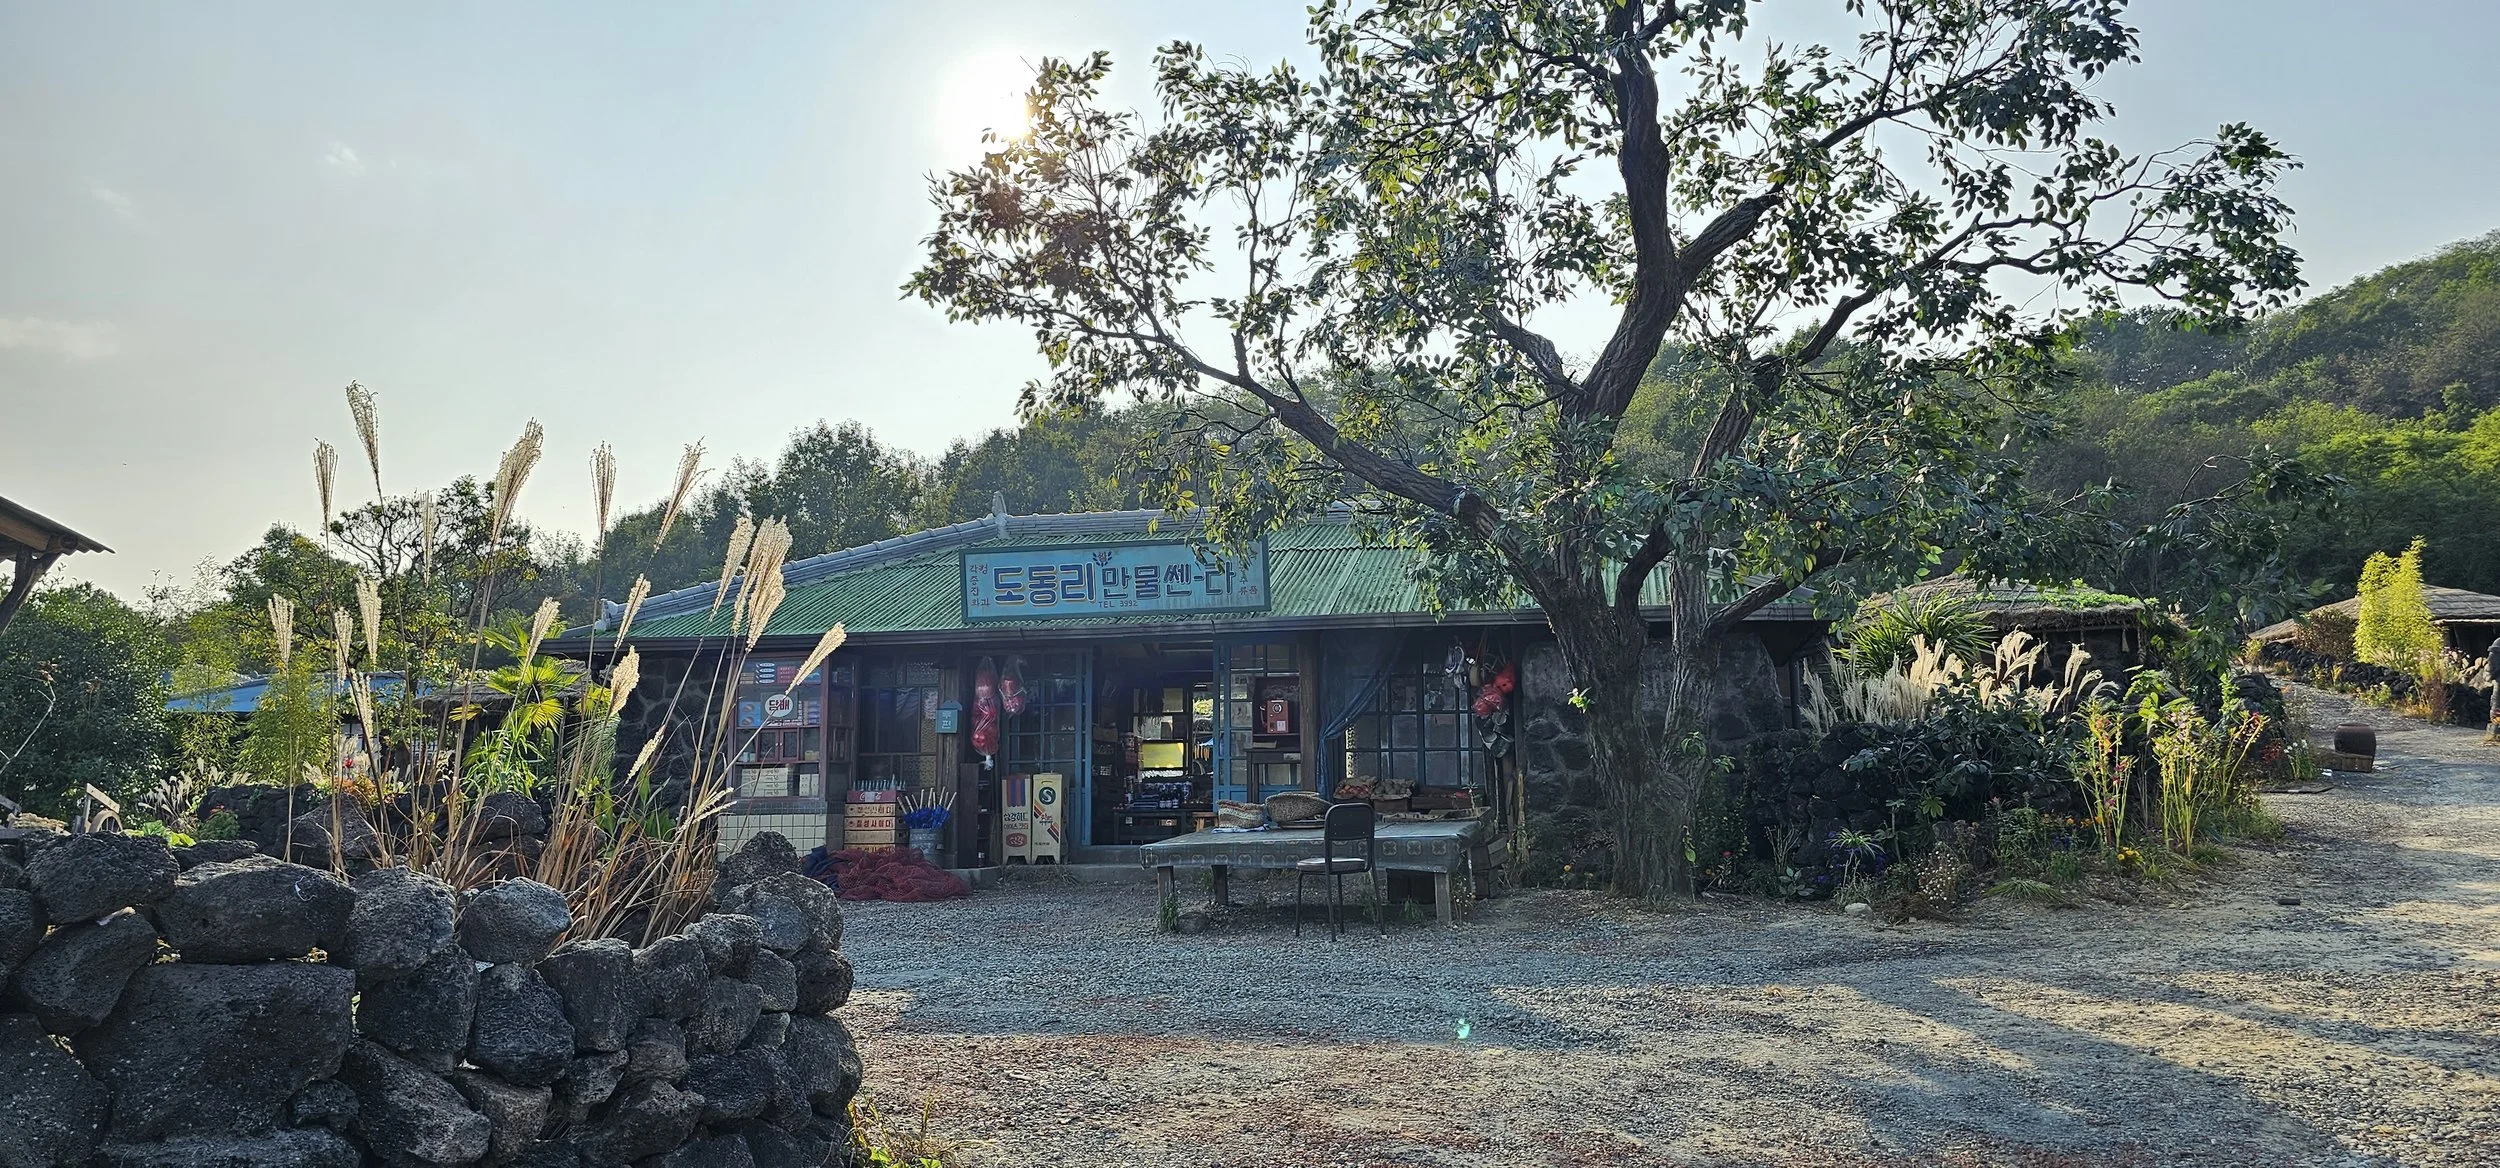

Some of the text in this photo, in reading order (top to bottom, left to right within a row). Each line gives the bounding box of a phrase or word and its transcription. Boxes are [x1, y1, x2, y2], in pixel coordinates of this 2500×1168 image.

[993, 561, 1237, 606] 도동리 만물쎈-타
[1098, 601, 1116, 609] TEL
[768, 699, 790, 712] 담배
[1041, 788, 1054, 803] S
[1004, 811, 1030, 822] 삼강하드
